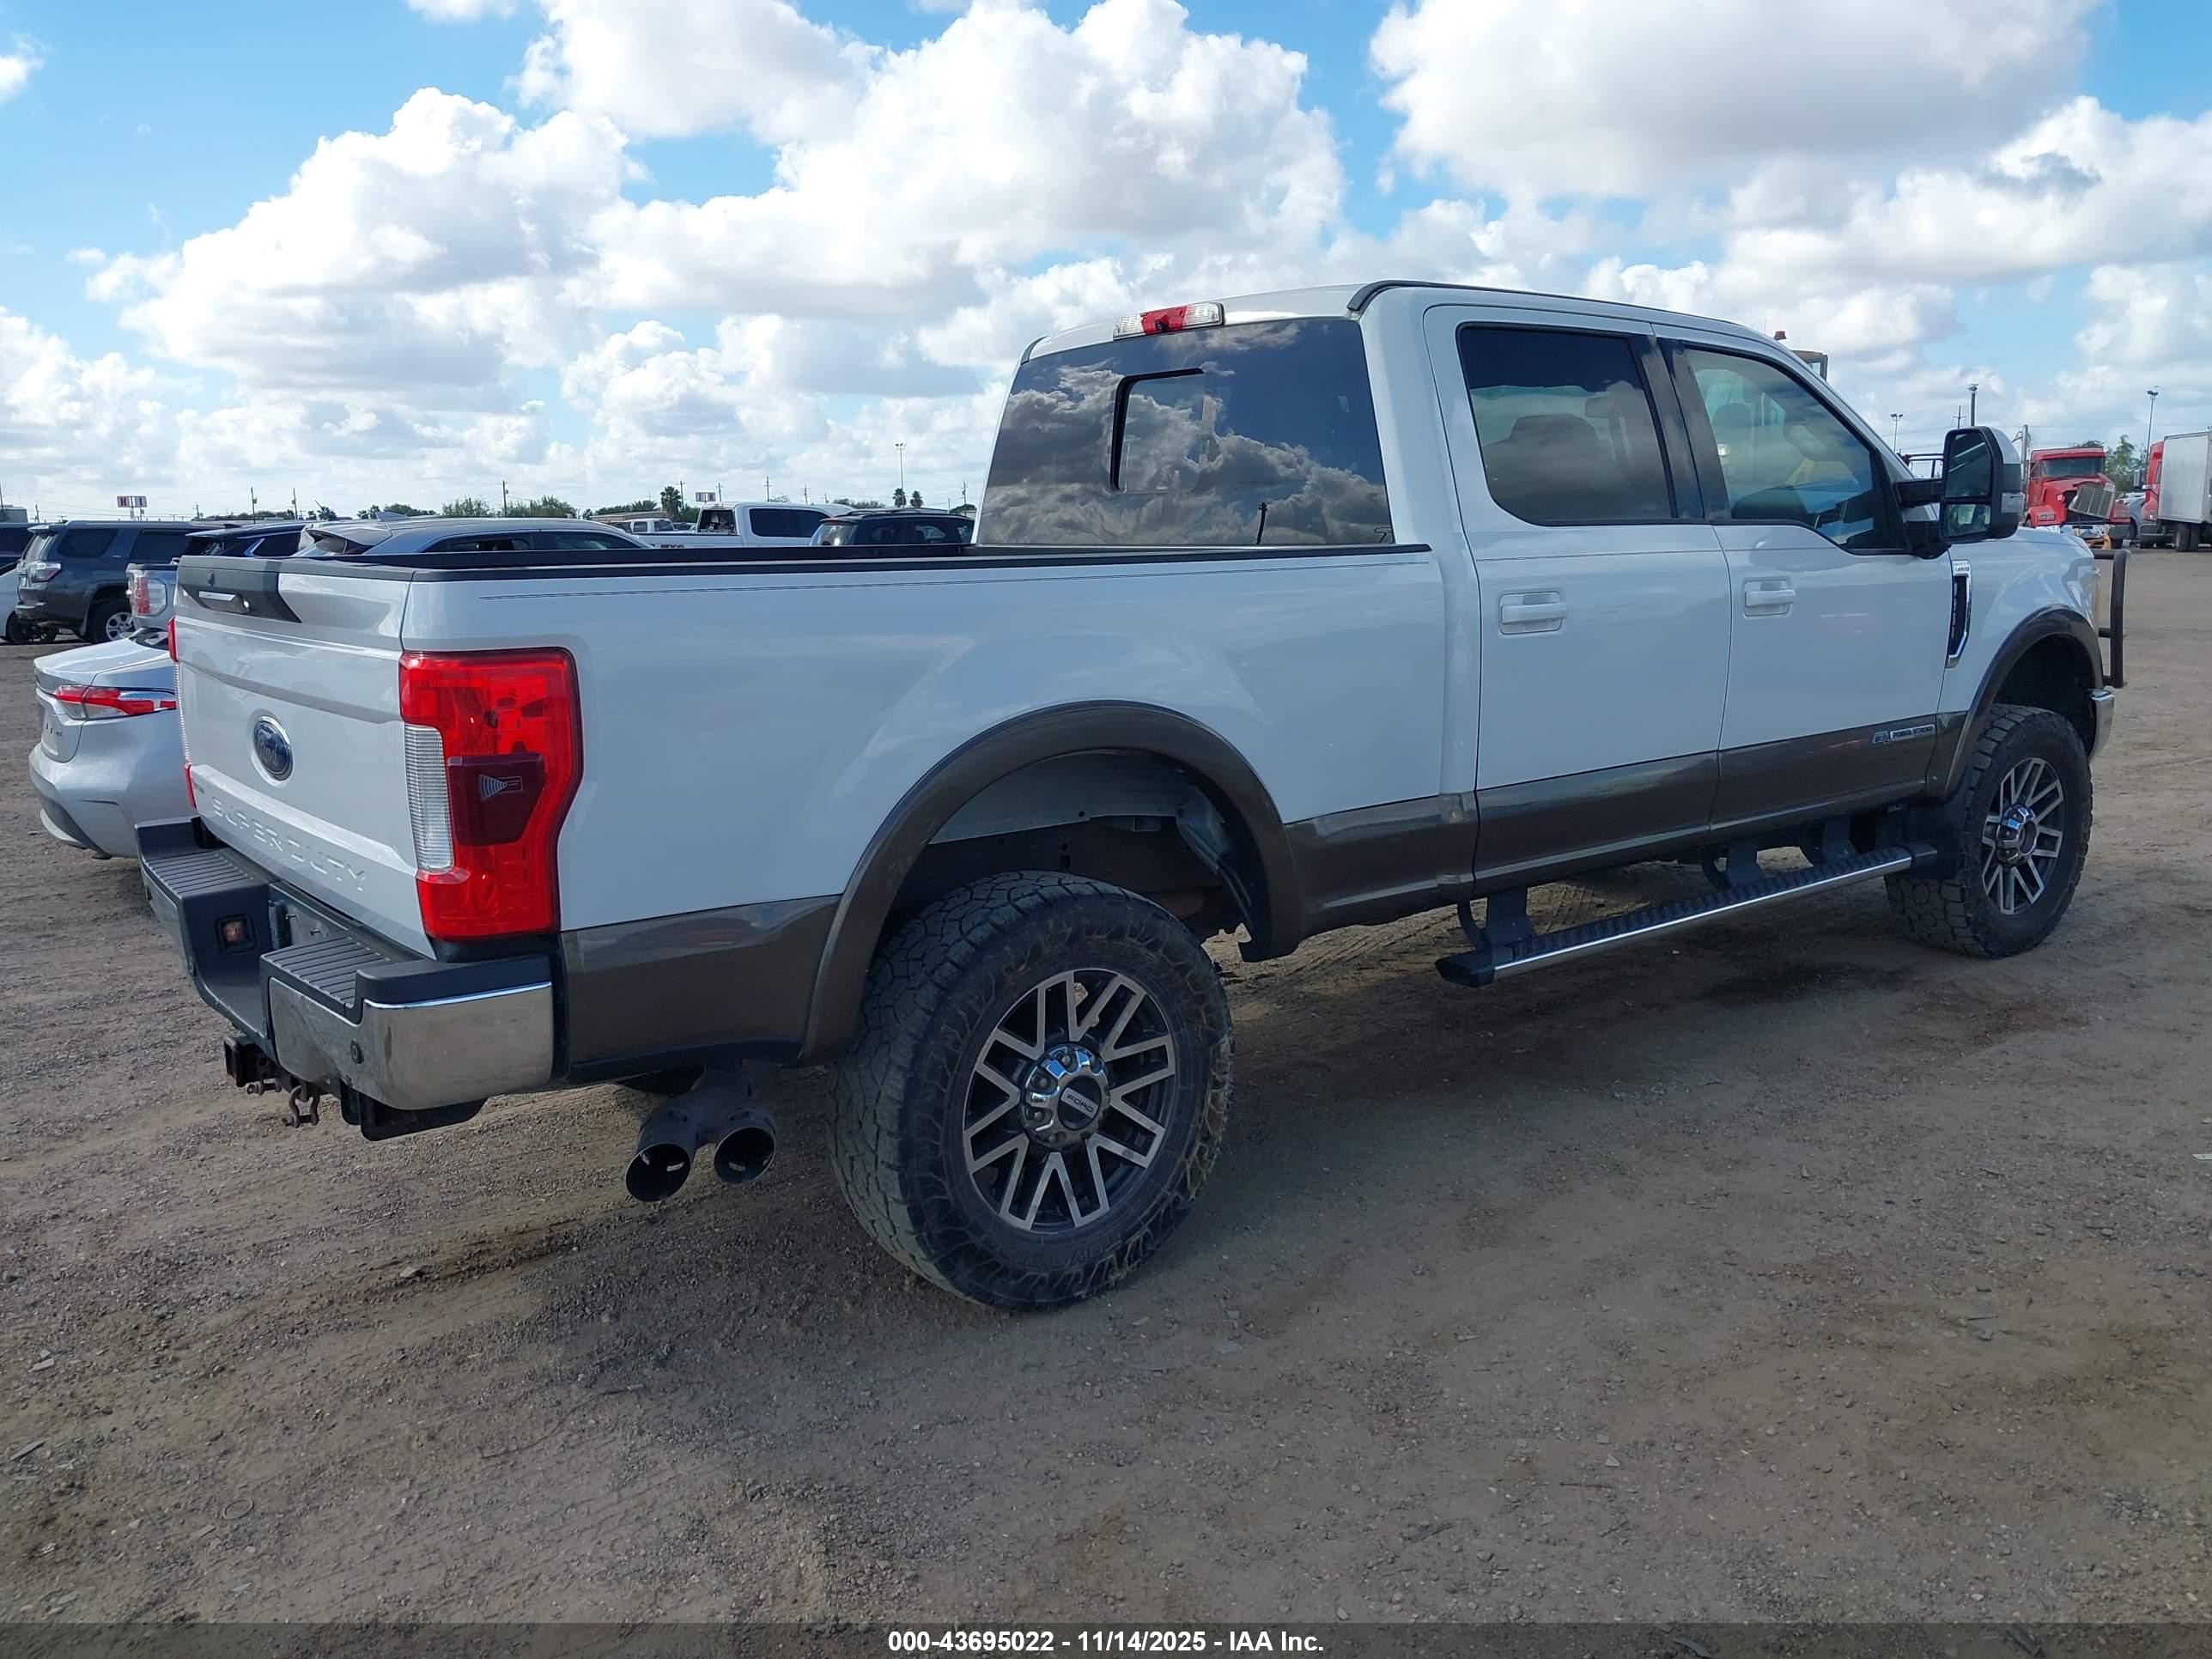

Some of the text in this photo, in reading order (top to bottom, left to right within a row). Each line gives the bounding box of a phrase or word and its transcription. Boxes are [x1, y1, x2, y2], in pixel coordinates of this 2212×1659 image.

[211, 796, 367, 892] SUPER DUTY
[1066, 1094, 1094, 1113] FORD
